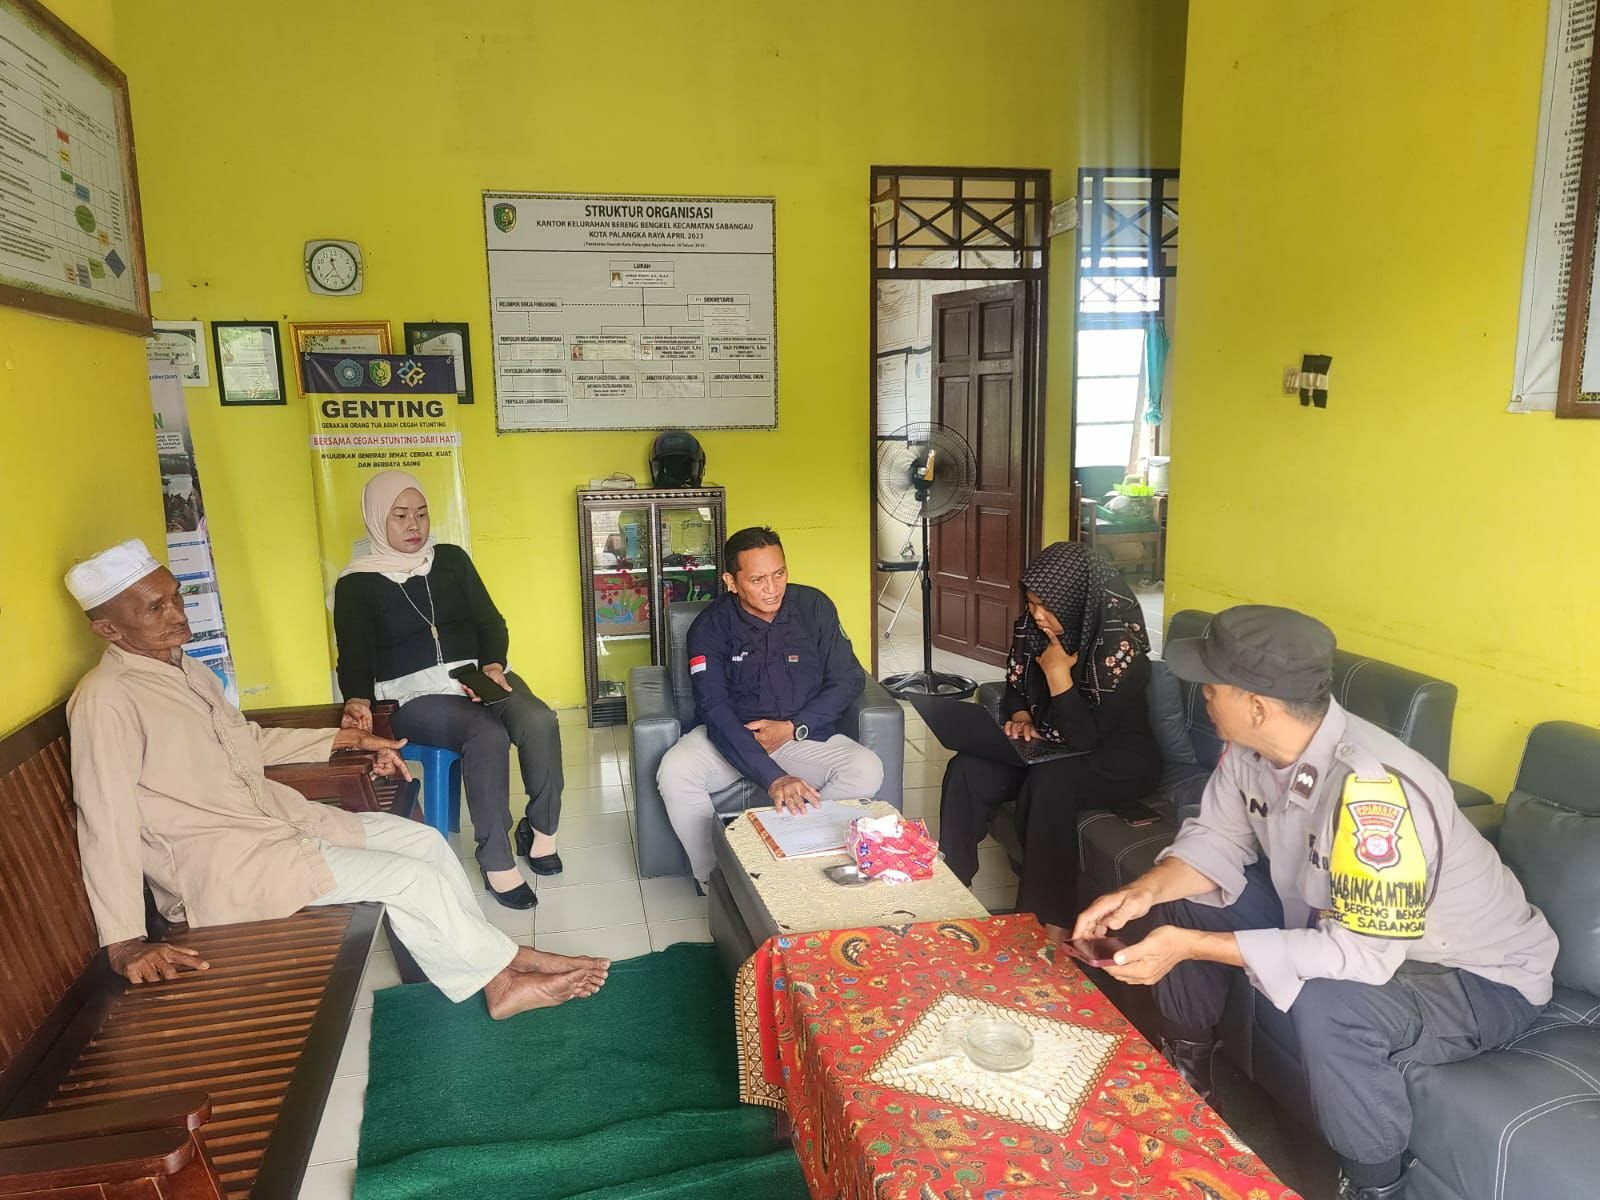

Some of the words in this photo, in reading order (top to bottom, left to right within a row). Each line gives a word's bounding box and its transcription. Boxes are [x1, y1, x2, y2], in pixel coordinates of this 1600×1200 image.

[584, 204, 644, 218] STRUKTUR
[645, 206, 714, 219] ORGANISASI
[536, 219, 566, 228] KANTOR
[567, 220, 610, 229] KELURAHAN
[611, 221, 639, 229] BERENG
[672, 222, 715, 230] KECAMATAN
[715, 223, 754, 231] SABANGAU
[588, 231, 608, 239] KOTA
[608, 231, 647, 239] PALANGKA
[647, 232, 666, 240] RAYA
[666, 232, 686, 240] APRIL
[687, 232, 704, 240] 2023
[321, 399, 444, 419] GENTING
[313, 436, 351, 446] BERSAMA
[352, 436, 379, 446] CEGAH
[380, 435, 418, 445] STUNTING
[420, 435, 438, 444] DARI
[1344, 901, 1389, 918] BERENG
